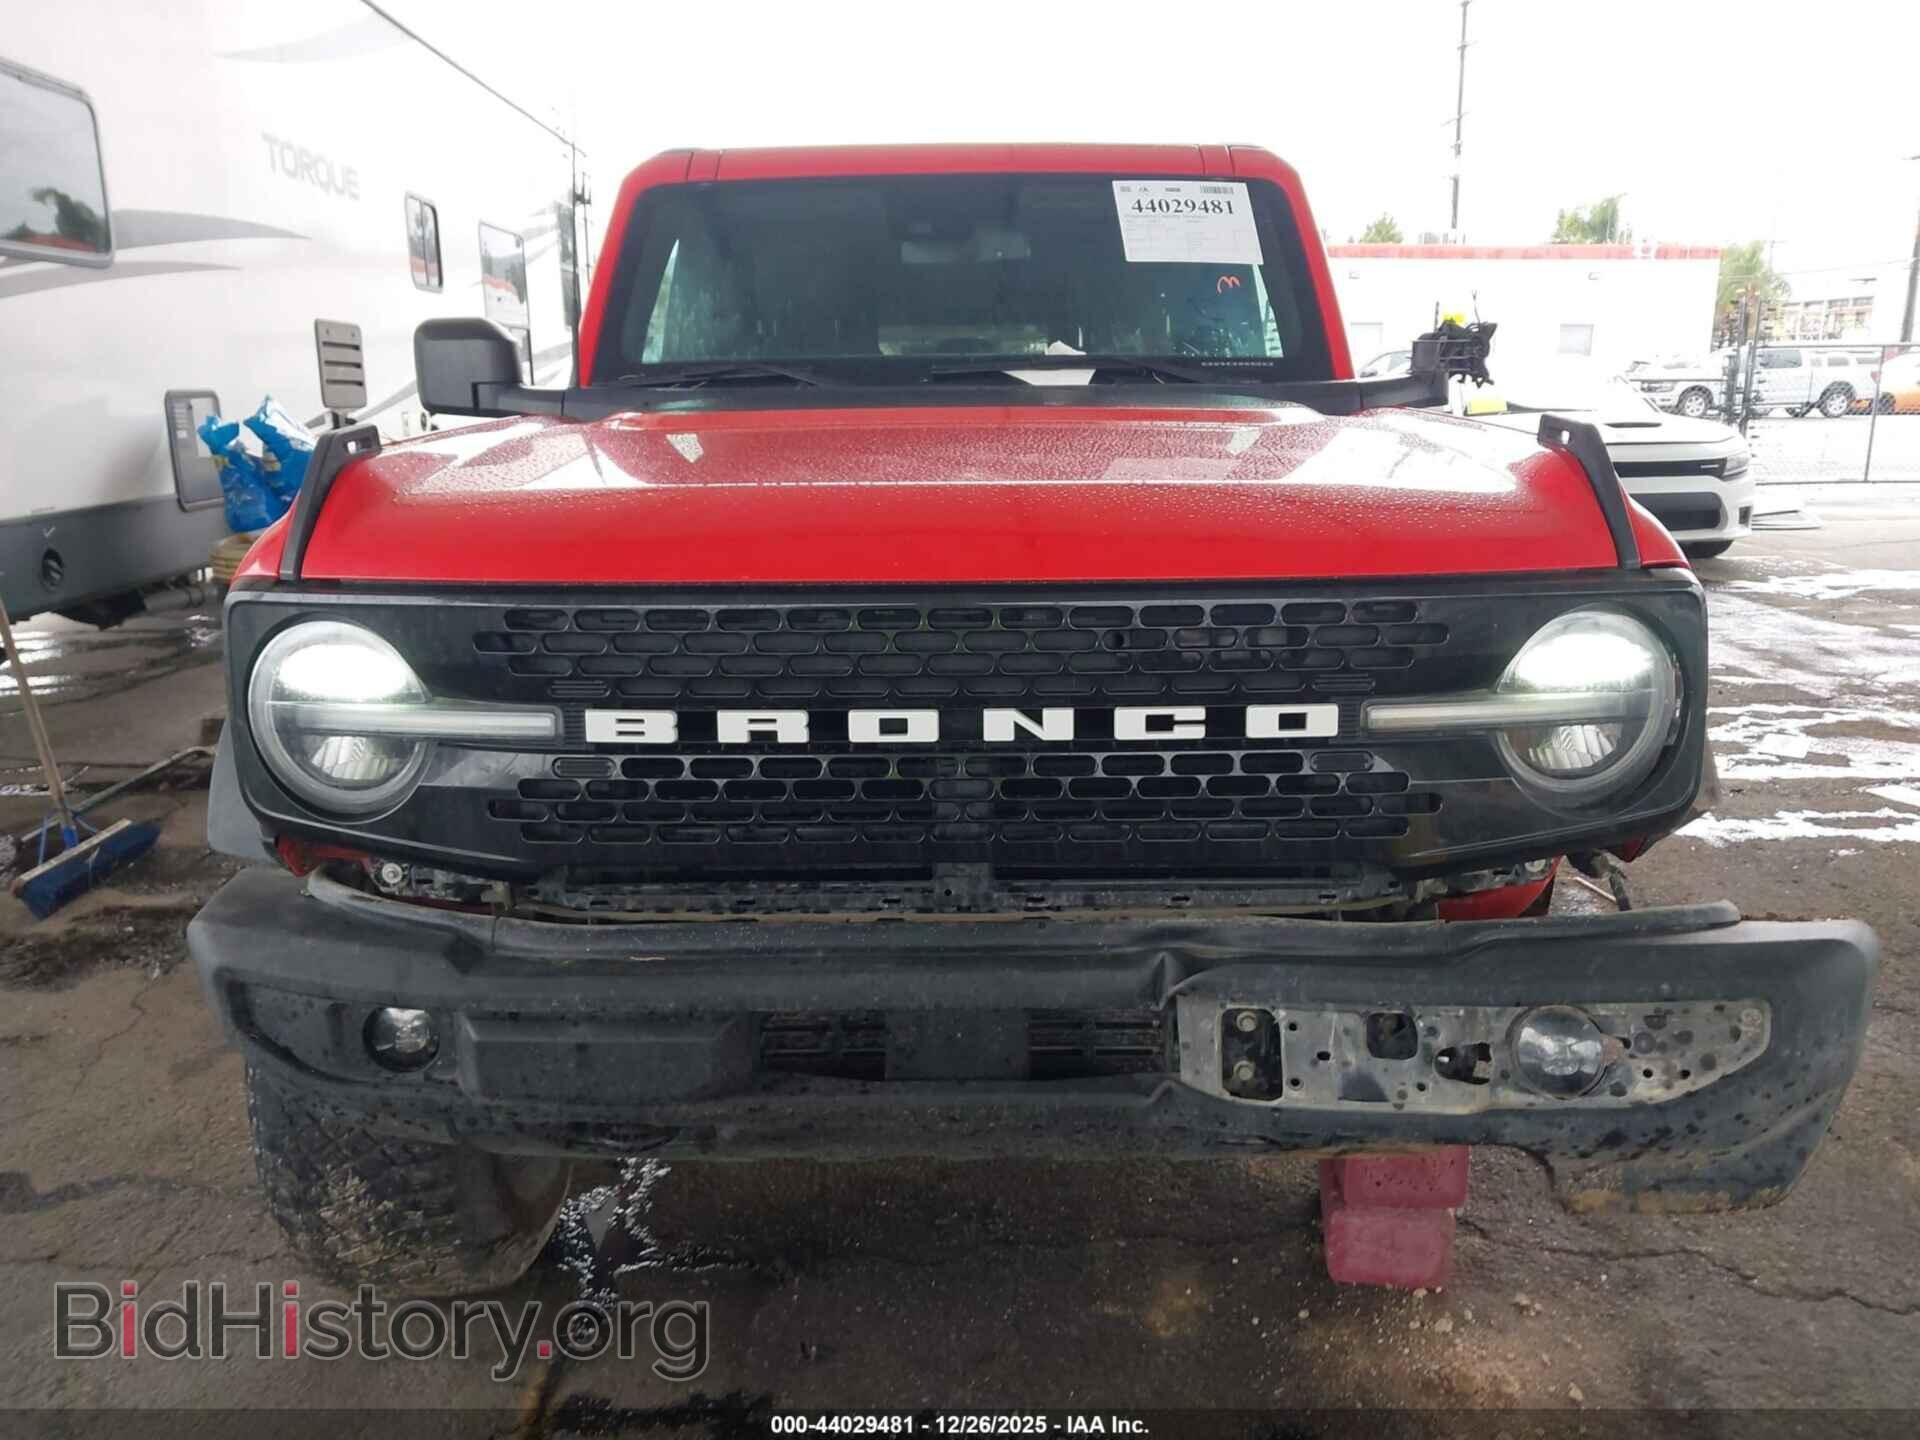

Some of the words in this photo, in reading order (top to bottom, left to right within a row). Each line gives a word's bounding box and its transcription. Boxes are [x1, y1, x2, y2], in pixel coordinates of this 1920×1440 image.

[261, 132, 360, 201] TORQUE
[1130, 198, 1235, 215] 44029481
[584, 704, 1340, 743] BRONCO
